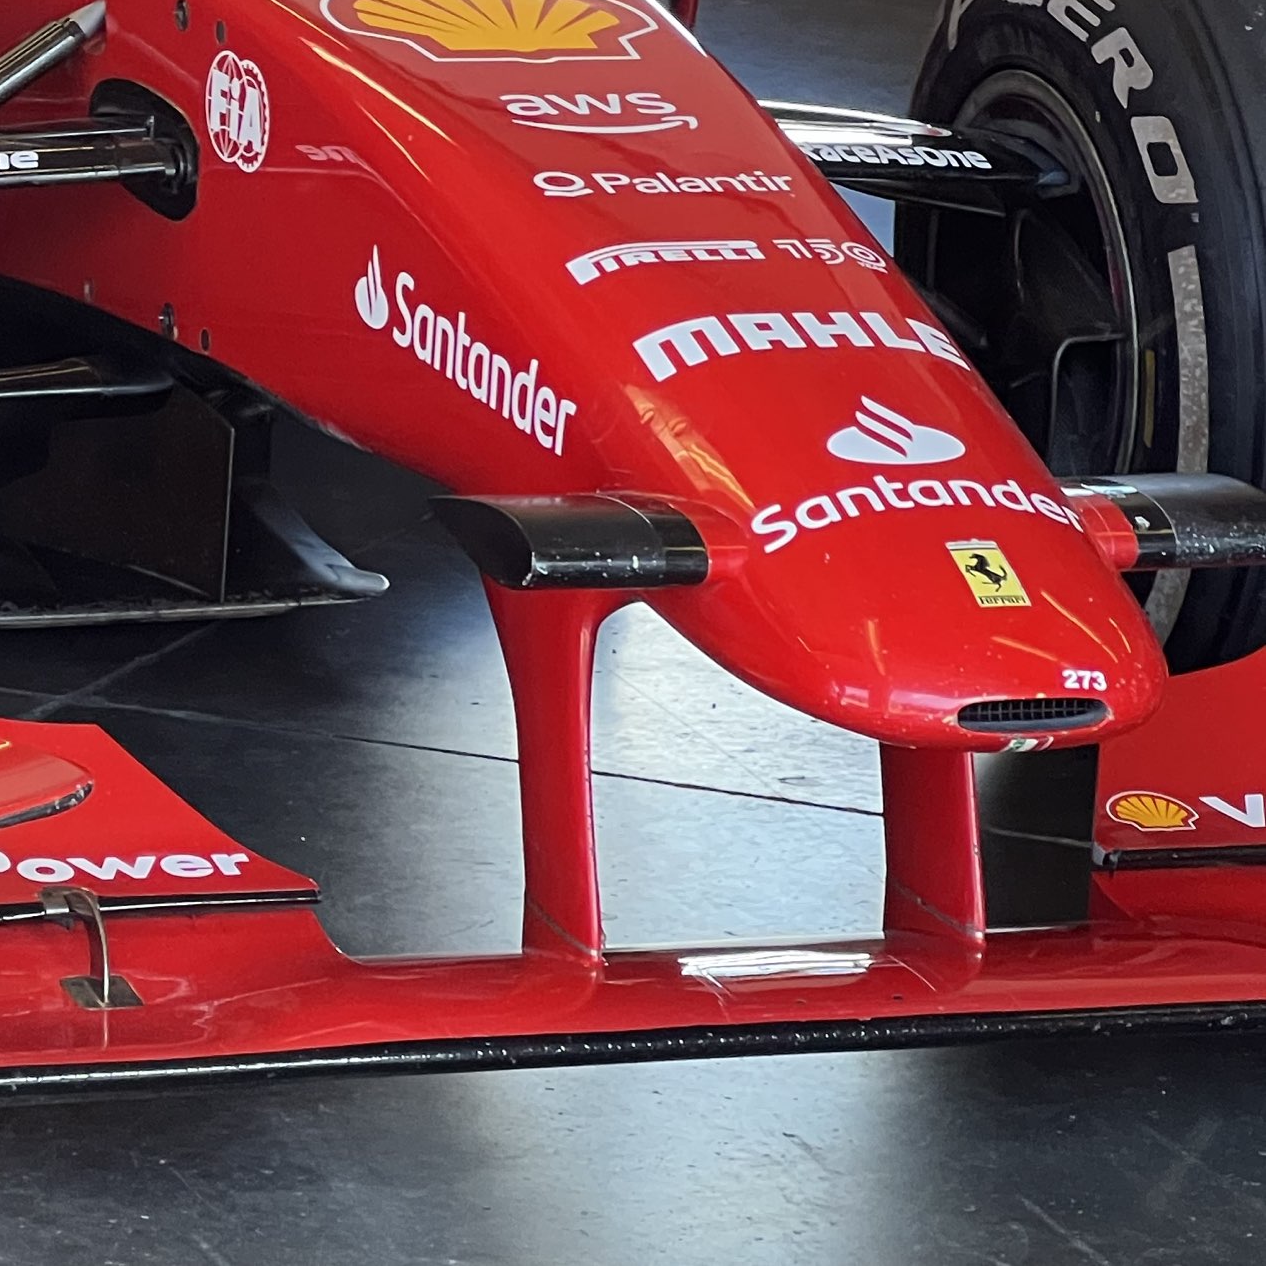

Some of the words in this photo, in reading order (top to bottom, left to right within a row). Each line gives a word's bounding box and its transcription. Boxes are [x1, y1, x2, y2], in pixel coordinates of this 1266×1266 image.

[500, 92, 677, 116] aws
[591, 170, 792, 194] Palantir
[565, 240, 766, 285] PIRELLI
[392, 271, 578, 457] Santander
[633, 311, 971, 383] MAHLE
[750, 475, 1085, 554] Santander
[1061, 669, 1108, 692] 273
